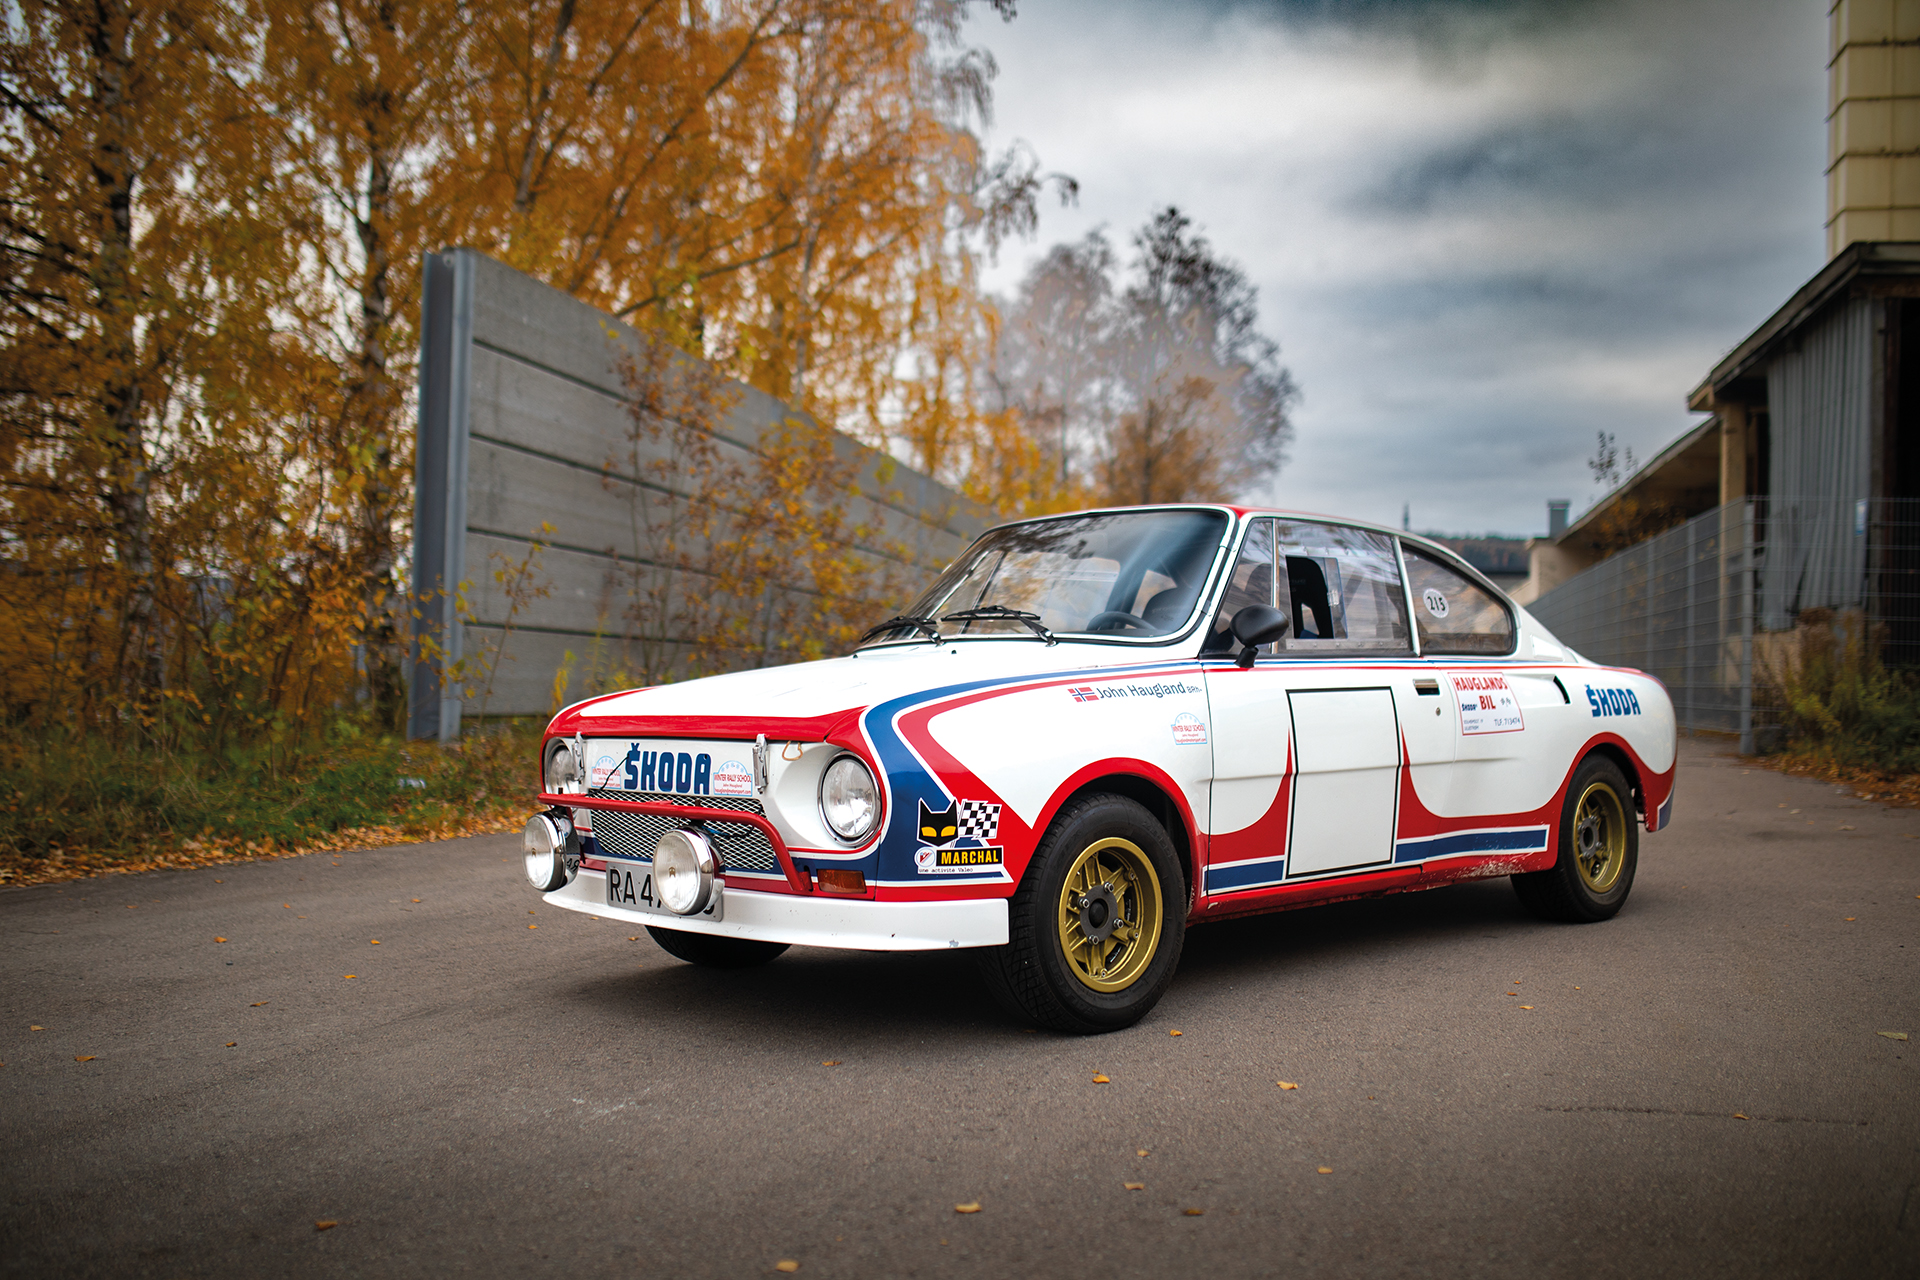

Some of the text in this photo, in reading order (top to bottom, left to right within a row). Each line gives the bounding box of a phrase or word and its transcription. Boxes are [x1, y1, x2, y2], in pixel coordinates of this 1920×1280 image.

[1427, 596, 1446, 611] 215
[1096, 686, 1128, 699] John
[1126, 681, 1186, 698] Haugland
[1452, 677, 1508, 691] HAUGLANDS
[1479, 695, 1496, 710] BIL
[1584, 684, 1641, 717] ŠKODA
[624, 743, 711, 795] ŠKODA
[727, 774, 736, 782] RALLY
[737, 774, 751, 782] SCHOOL
[941, 850, 999, 864] MARCHAL
